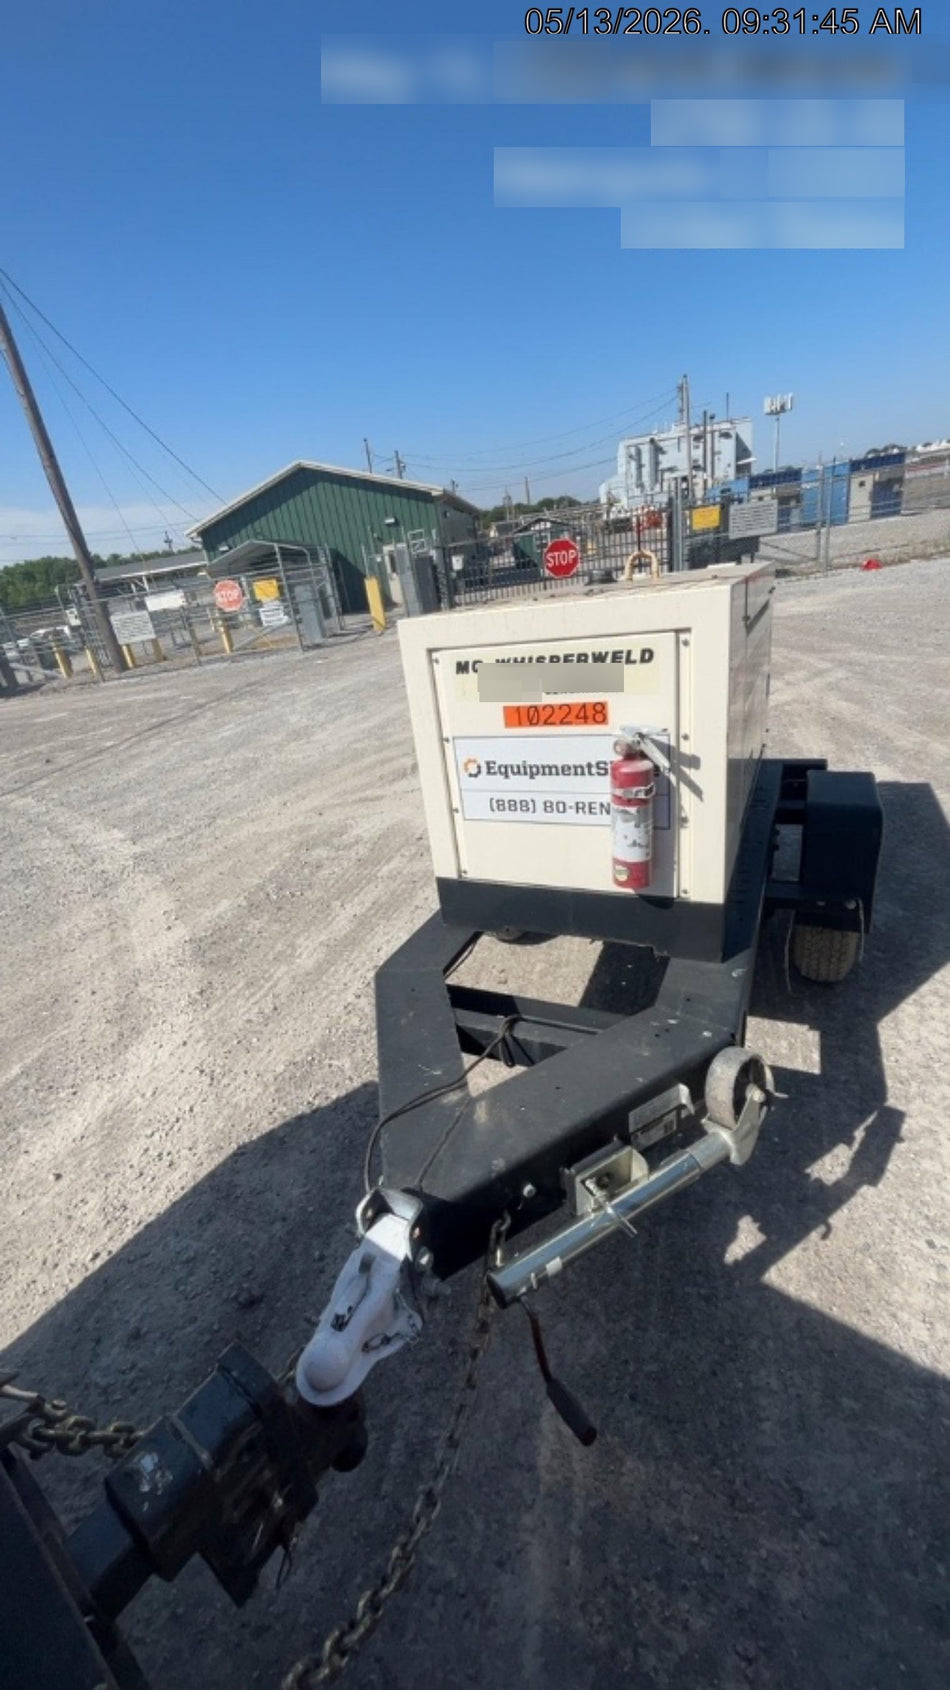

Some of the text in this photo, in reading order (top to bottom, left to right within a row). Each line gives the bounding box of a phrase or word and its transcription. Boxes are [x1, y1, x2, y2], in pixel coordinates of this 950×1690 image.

[546, 549, 577, 568] STOP
[514, 702, 607, 726] 102248
[485, 759, 660, 779] EquipmentS
[489, 796, 612, 816] (888) 80-REN
